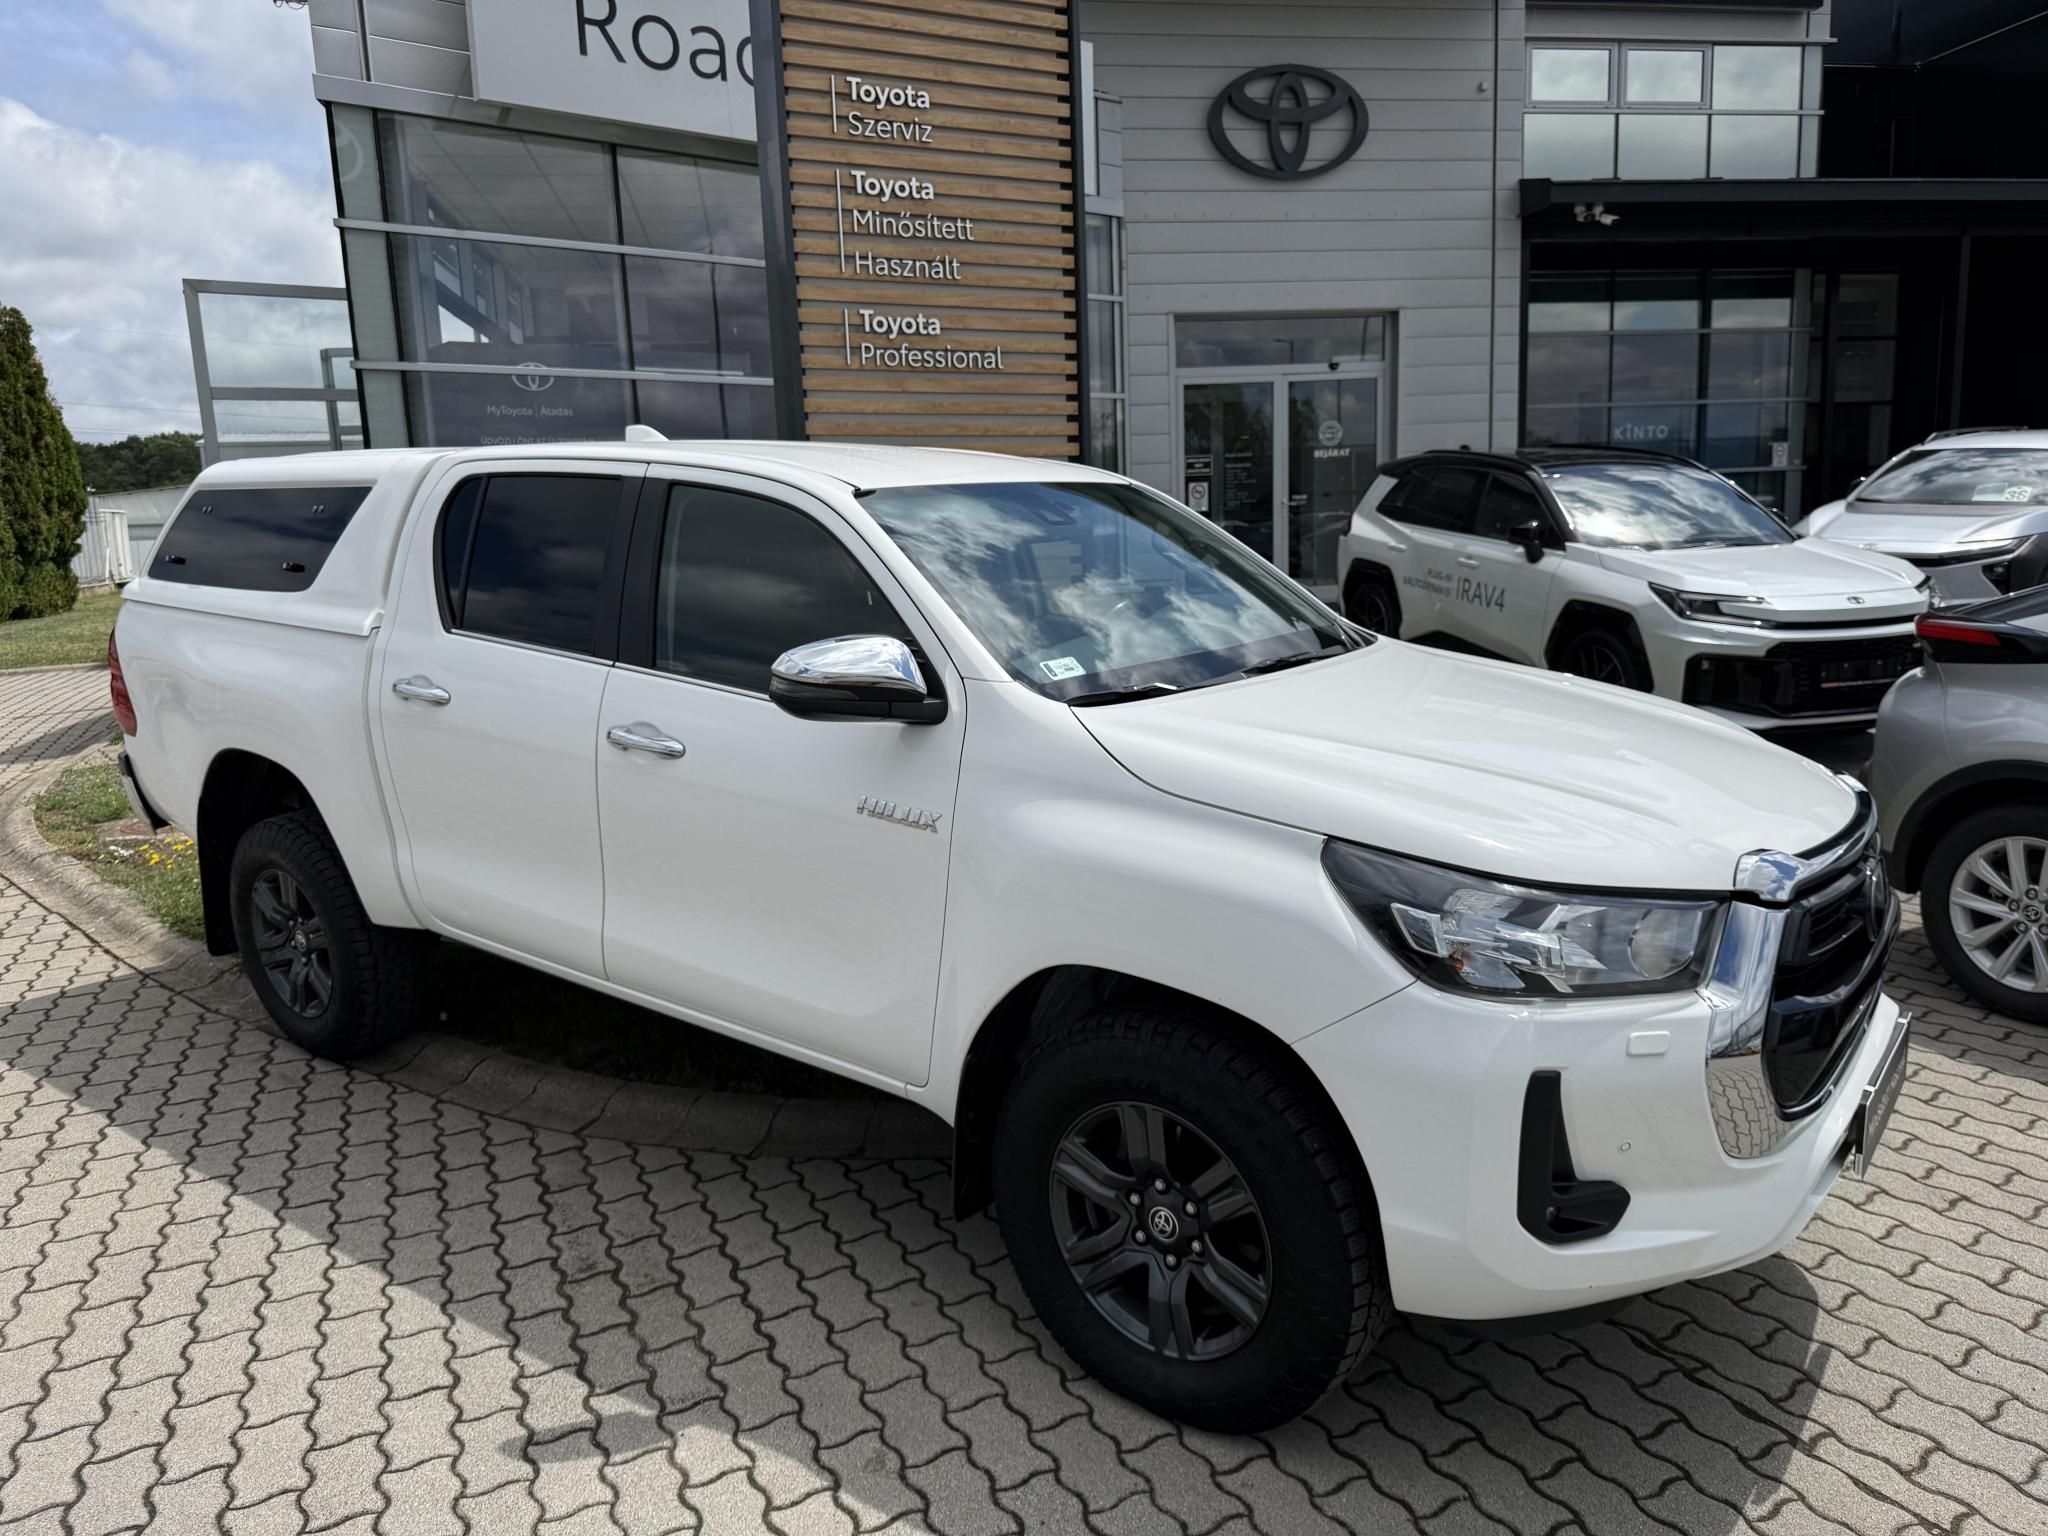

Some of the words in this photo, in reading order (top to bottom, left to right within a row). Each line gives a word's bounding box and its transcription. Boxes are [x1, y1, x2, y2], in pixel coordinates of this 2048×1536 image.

[846, 76, 931, 110] Toyota
[848, 111, 933, 143] Szerviz
[850, 170, 935, 202] Toyota
[853, 209, 975, 241] Minősített
[855, 251, 962, 280] Használt
[859, 309, 942, 339] Toyota
[861, 343, 1004, 369] Professional
[487, 405, 534, 417] MyToyota
[1614, 423, 1669, 439] KINTO
[1313, 447, 1350, 459] BEJÁRAT
[856, 795, 943, 834] HILUX
